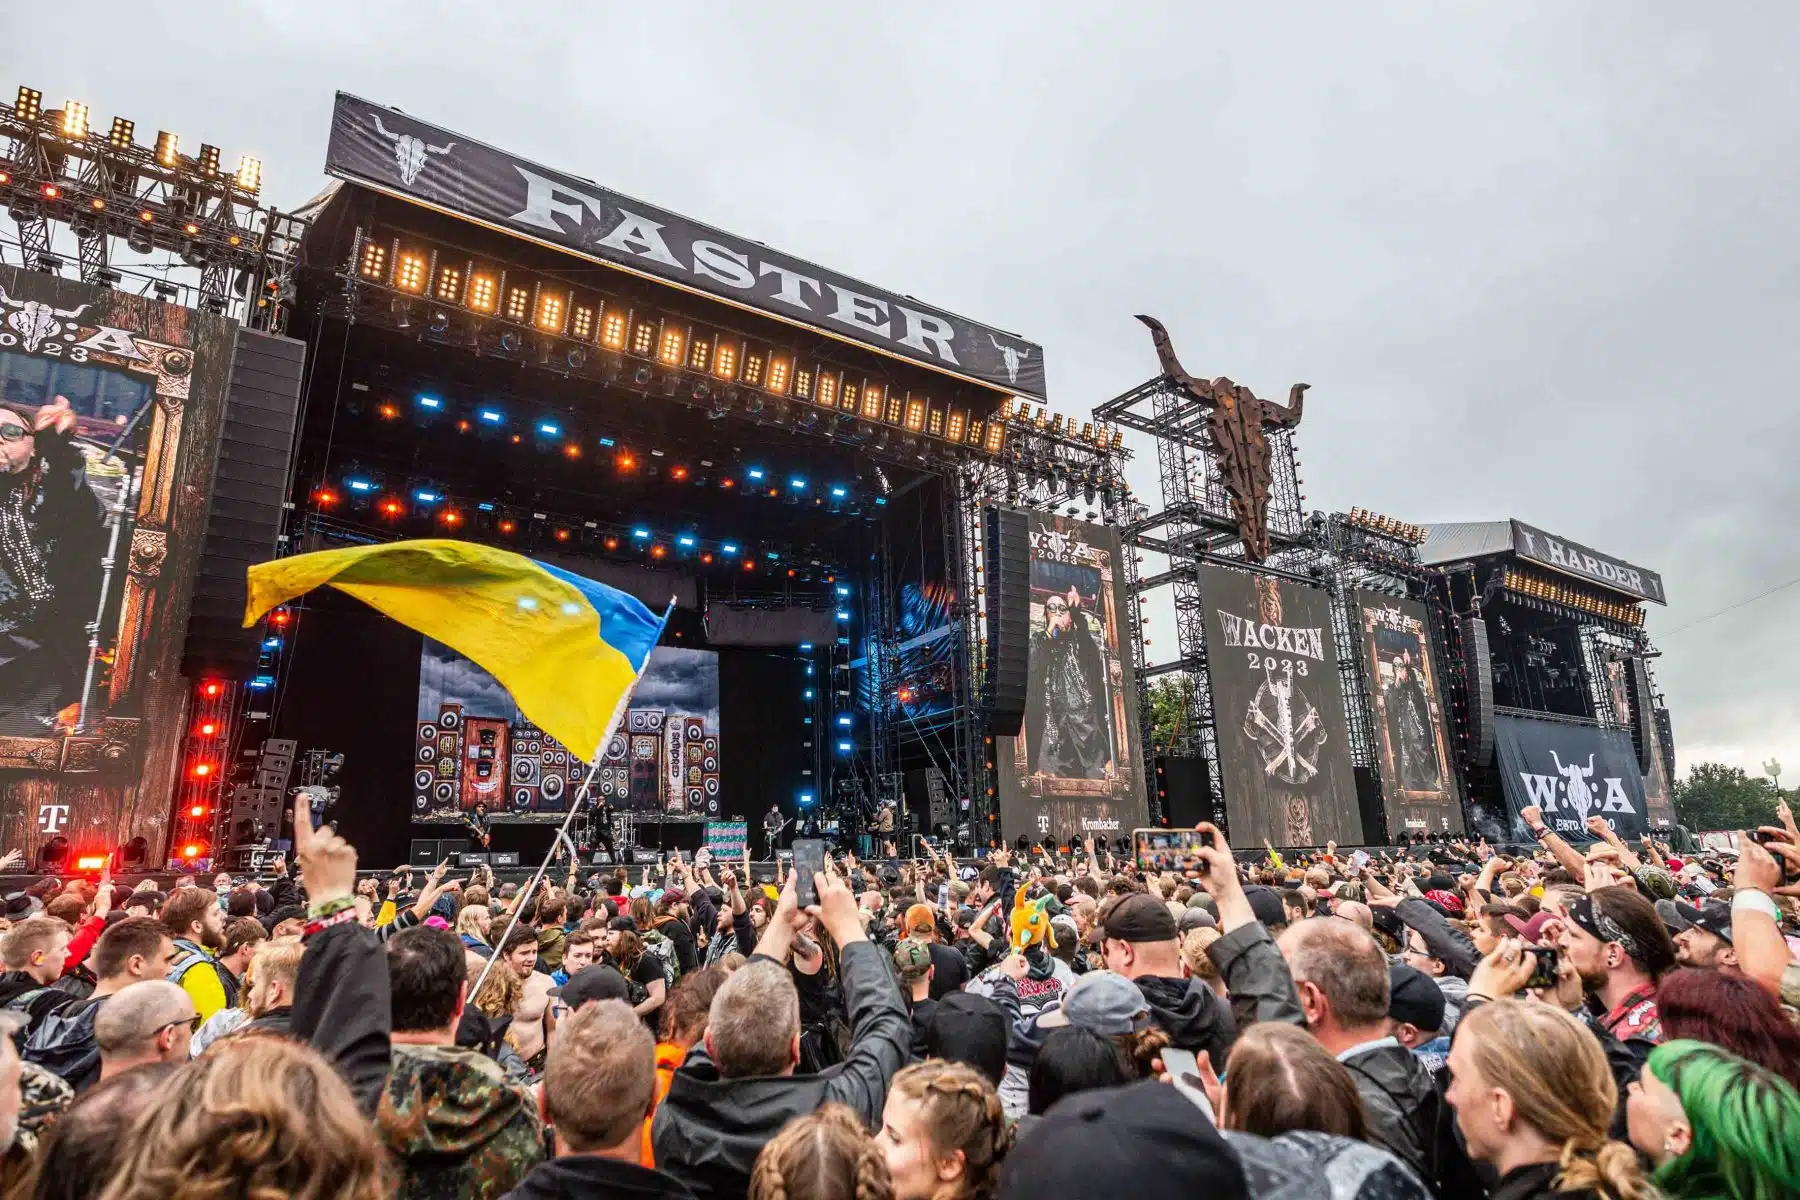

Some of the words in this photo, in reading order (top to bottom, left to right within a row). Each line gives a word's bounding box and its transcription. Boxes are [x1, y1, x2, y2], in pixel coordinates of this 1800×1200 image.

[508, 164, 961, 366] FASTER
[0, 333, 89, 363] 023
[1544, 535, 1646, 594] HARDER
[1217, 609, 1324, 661] WACKEN
[1247, 652, 1309, 677] 2023
[1081, 817, 1120, 831] Krombacher
[1555, 818, 1581, 831] ESTD.
